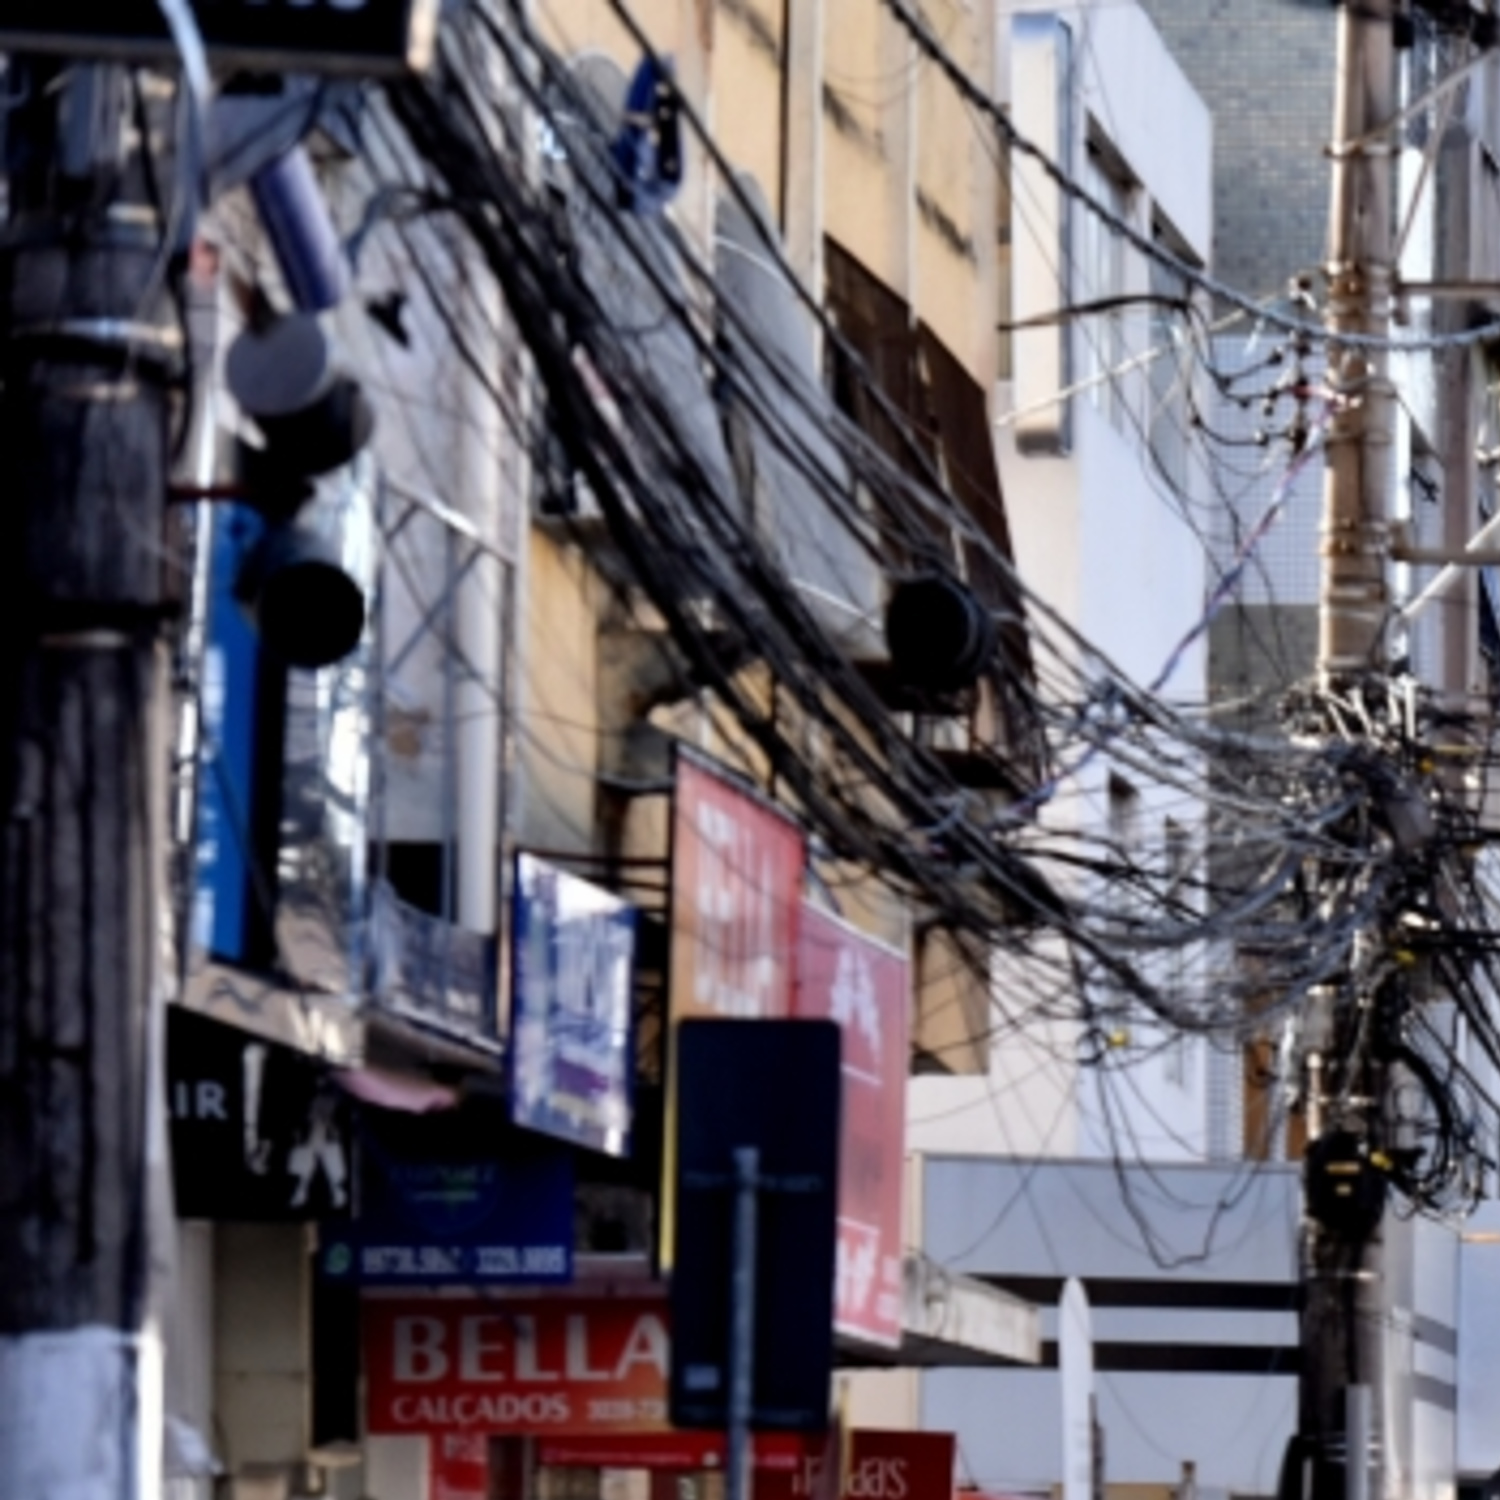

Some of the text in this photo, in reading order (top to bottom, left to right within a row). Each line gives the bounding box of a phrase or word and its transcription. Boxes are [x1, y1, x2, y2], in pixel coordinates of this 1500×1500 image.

[168, 1077, 230, 1121] IR
[390, 1312, 669, 1384] BELLA
[390, 1393, 571, 1430] CALÇADOS
